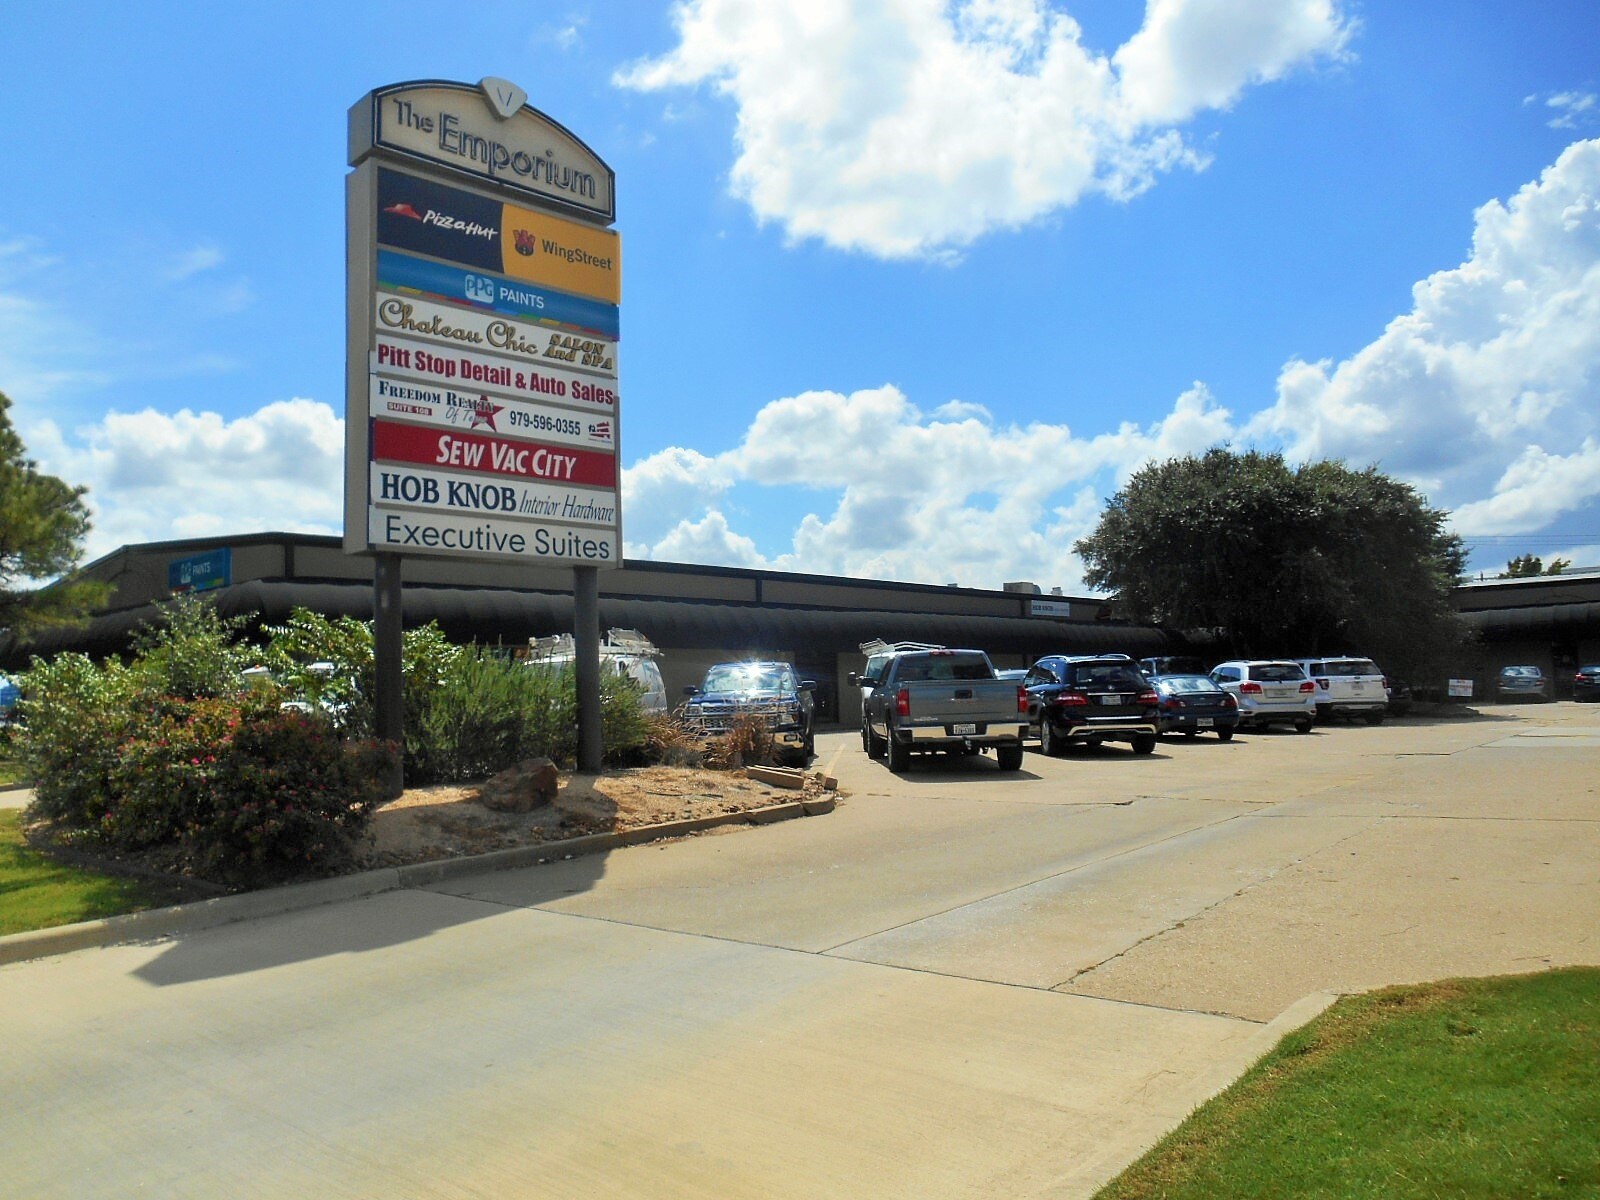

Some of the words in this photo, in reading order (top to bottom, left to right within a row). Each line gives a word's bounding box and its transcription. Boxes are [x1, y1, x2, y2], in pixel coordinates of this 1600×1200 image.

[393, 98, 434, 134] The
[439, 111, 596, 199] Emporium
[541, 239, 613, 271] WingStreet
[465, 276, 494, 302] PPG
[500, 287, 545, 309] PAINTS
[379, 298, 483, 344] Chateau
[487, 320, 539, 355] Chic
[542, 345, 577, 362] And
[581, 353, 613, 370] SPA
[549, 333, 606, 355] SALON
[377, 343, 411, 369] Pitt
[415, 350, 456, 378] Stop
[460, 358, 512, 387] Detail
[515, 372, 527, 391] &
[530, 372, 566, 397] Auto
[571, 380, 614, 405] Sales
[378, 381, 441, 404] FREEDOM
[388, 402, 413, 413] SUITE
[445, 406, 459, 424] Of
[510, 410, 581, 436] 979-596-0355
[436, 435, 485, 467] SEW
[490, 442, 528, 474] VAC
[532, 449, 577, 479] CITY
[380, 473, 440, 503] HOB
[447, 480, 517, 511] KNOB
[519, 489, 560, 516] Interior
[562, 494, 614, 521] Hardware
[386, 515, 526, 553] Executive
[535, 528, 610, 559] Suites
